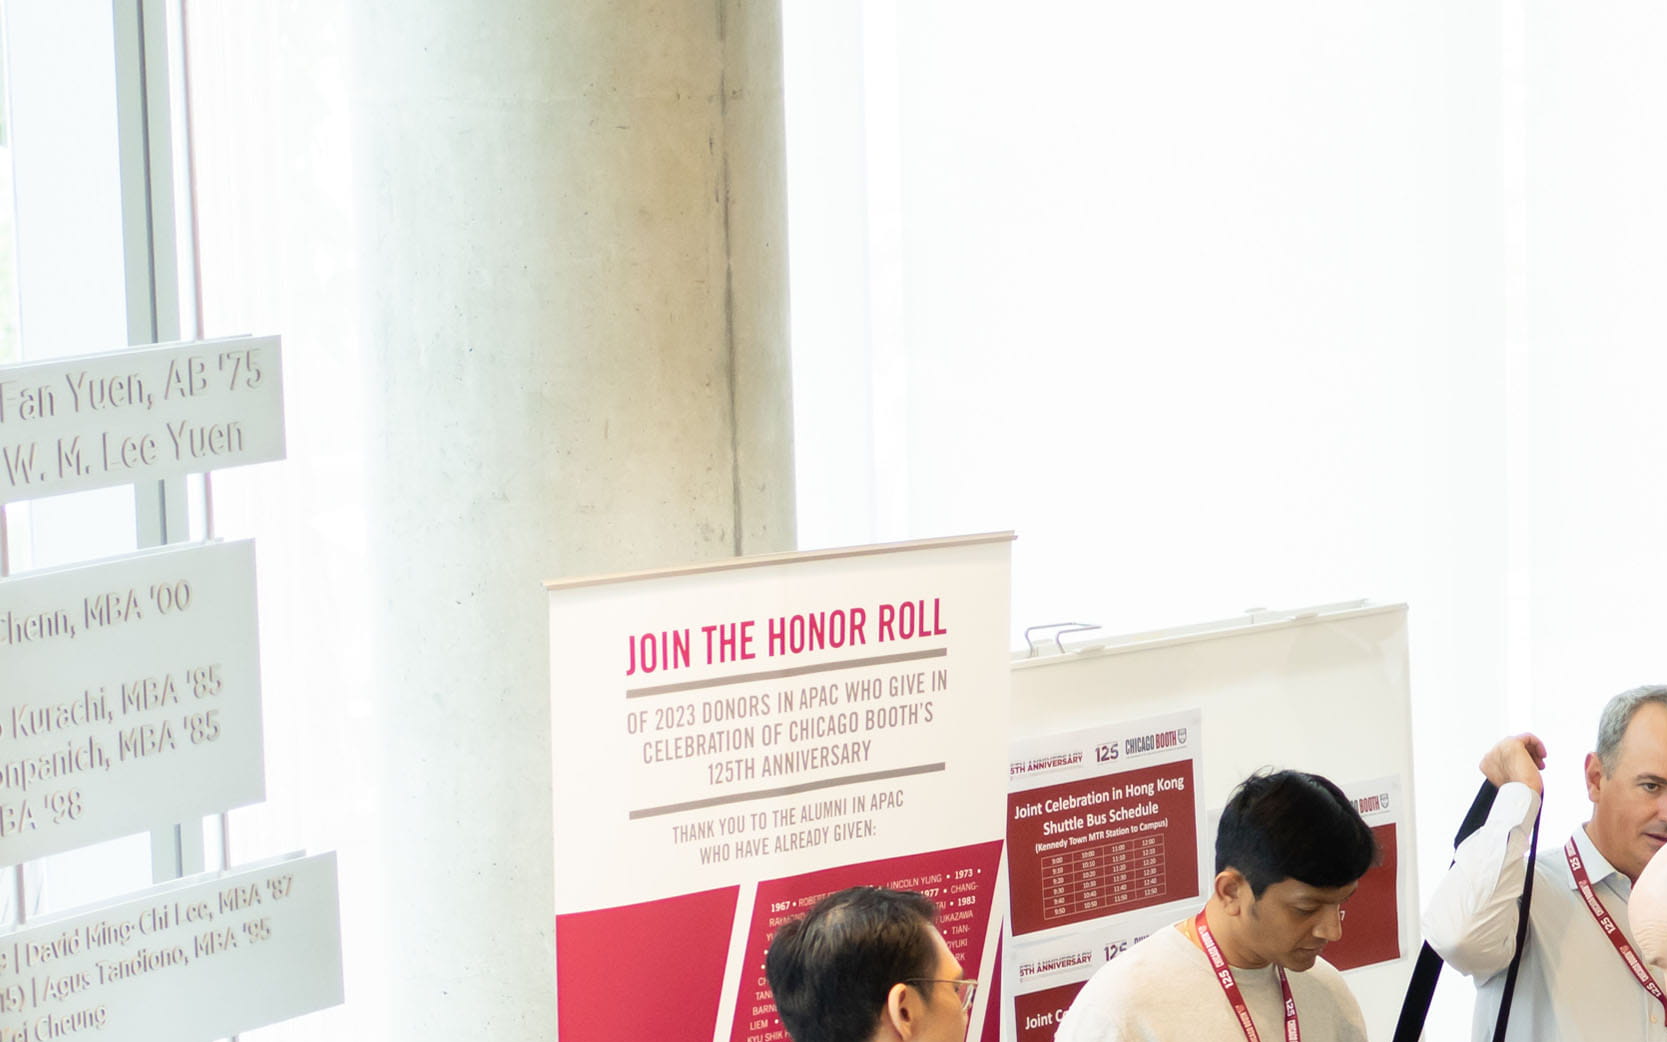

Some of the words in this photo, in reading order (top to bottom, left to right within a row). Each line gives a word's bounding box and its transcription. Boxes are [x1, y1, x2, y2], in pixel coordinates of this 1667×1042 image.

[65, 371, 154, 411] Yuen,
[164, 356, 208, 401] AB
[217, 348, 263, 391] '75
[3, 441, 45, 486] W.
[58, 435, 91, 478] M.
[102, 431, 157, 472] Lee
[166, 419, 243, 461] Yuen
[84, 588, 142, 629] MBA
[150, 580, 192, 615] '00
[626, 629, 690, 676] JOIN
[702, 620, 756, 665] THE
[768, 607, 867, 657] HONOR
[878, 598, 947, 643] ROLL
[12, 687, 113, 740] Kurachi,
[121, 674, 178, 715] MBA
[186, 664, 223, 699] '85
[627, 711, 649, 735] OF
[655, 704, 696, 730] 2023
[703, 694, 771, 723] DONORS
[777, 690, 793, 713] IN
[799, 684, 839, 710] APAC
[845, 678, 882, 705] WHO
[889, 672, 926, 697] GIVE
[931, 670, 948, 691] IN
[119, 720, 176, 761] MBA
[183, 710, 221, 744] '85
[643, 727, 755, 764] CELEBRATION
[762, 723, 782, 746] OF
[789, 711, 859, 742] CHICAGO
[865, 701, 934, 731] BOOTH'S
[1095, 743, 1119, 763] 125
[1125, 734, 1155, 755] CHICAGO
[1155, 730, 1177, 748] BOOTH
[707, 756, 755, 785] 125TH
[761, 740, 872, 780] ANNIVERSARY
[1027, 755, 1083, 772] ANNIVERSARY
[672, 820, 715, 845] THANK
[718, 814, 746, 841] YOU
[750, 811, 767, 833] TO
[772, 807, 797, 829] THE
[800, 798, 848, 825] ALUMNI
[852, 795, 866, 814] IN
[870, 789, 904, 812] APAC
[1014, 801, 1043, 820] Joint
[1044, 790, 1110, 813] Celebration
[1112, 787, 1123, 800] in
[1126, 780, 1155, 798] Hong
[1157, 776, 1184, 792] Kong
[1043, 815, 1084, 836] Shuttle
[1087, 812, 1107, 827] Bus
[1109, 801, 1159, 822] Schedule
[700, 843, 731, 866] WHO
[735, 837, 770, 861] HAVE
[774, 829, 829, 857] ALREADY
[834, 820, 877, 843] GIVEN:
[1035, 840, 1068, 854] (Kennedy
[1069, 836, 1087, 846] Town
[1088, 832, 1104, 842] MTR
[1105, 827, 1129, 838] Station
[1131, 825, 1138, 833] to
[1139, 818, 1168, 831] Campus)
[954, 868, 974, 880] 1973
[771, 900, 791, 913] 1967
[957, 895, 976, 906] 1983
[26, 927, 79, 967] David
[86, 904, 170, 950] Ming-Chi
[218, 883, 262, 914] MBA
[1600, 916, 1616, 934] 125
[43, 971, 91, 1003] Agus
[194, 926, 238, 959] MBA
[1217, 971, 1234, 989] 125
[34, 1004, 107, 1042] Cheung
[1285, 998, 1295, 1017] 125
